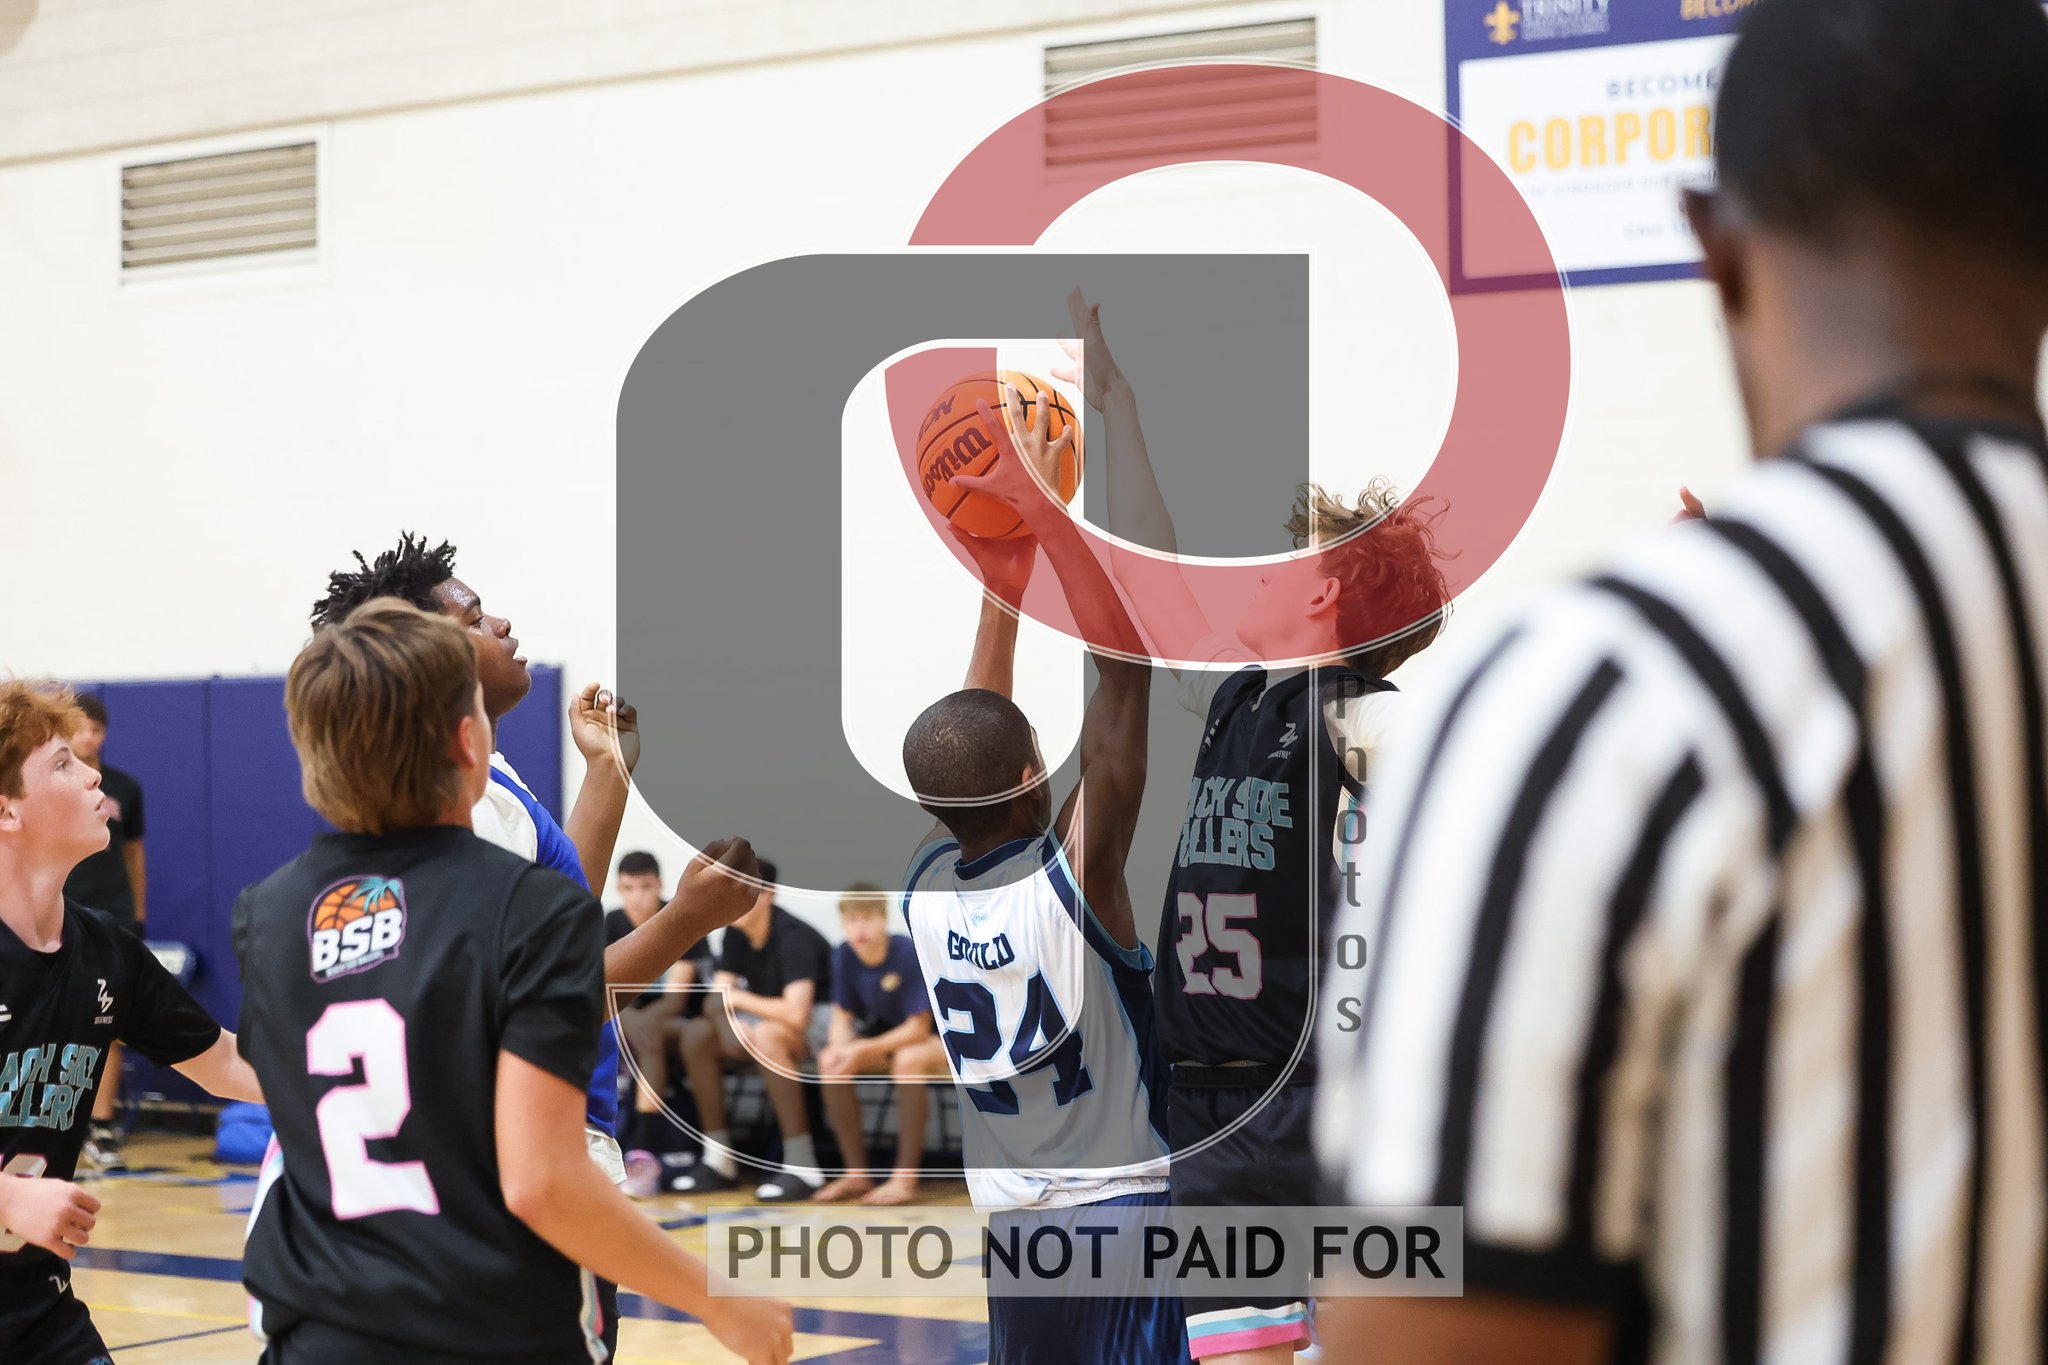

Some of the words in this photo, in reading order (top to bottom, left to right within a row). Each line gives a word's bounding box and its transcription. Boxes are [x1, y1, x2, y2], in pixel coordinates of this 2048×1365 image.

[312, 907, 403, 973] BSB
[947, 929, 1016, 971] GOULD
[1176, 891, 1263, 1000] 25
[933, 968, 1097, 1116] 24
[306, 997, 441, 1222] 2
